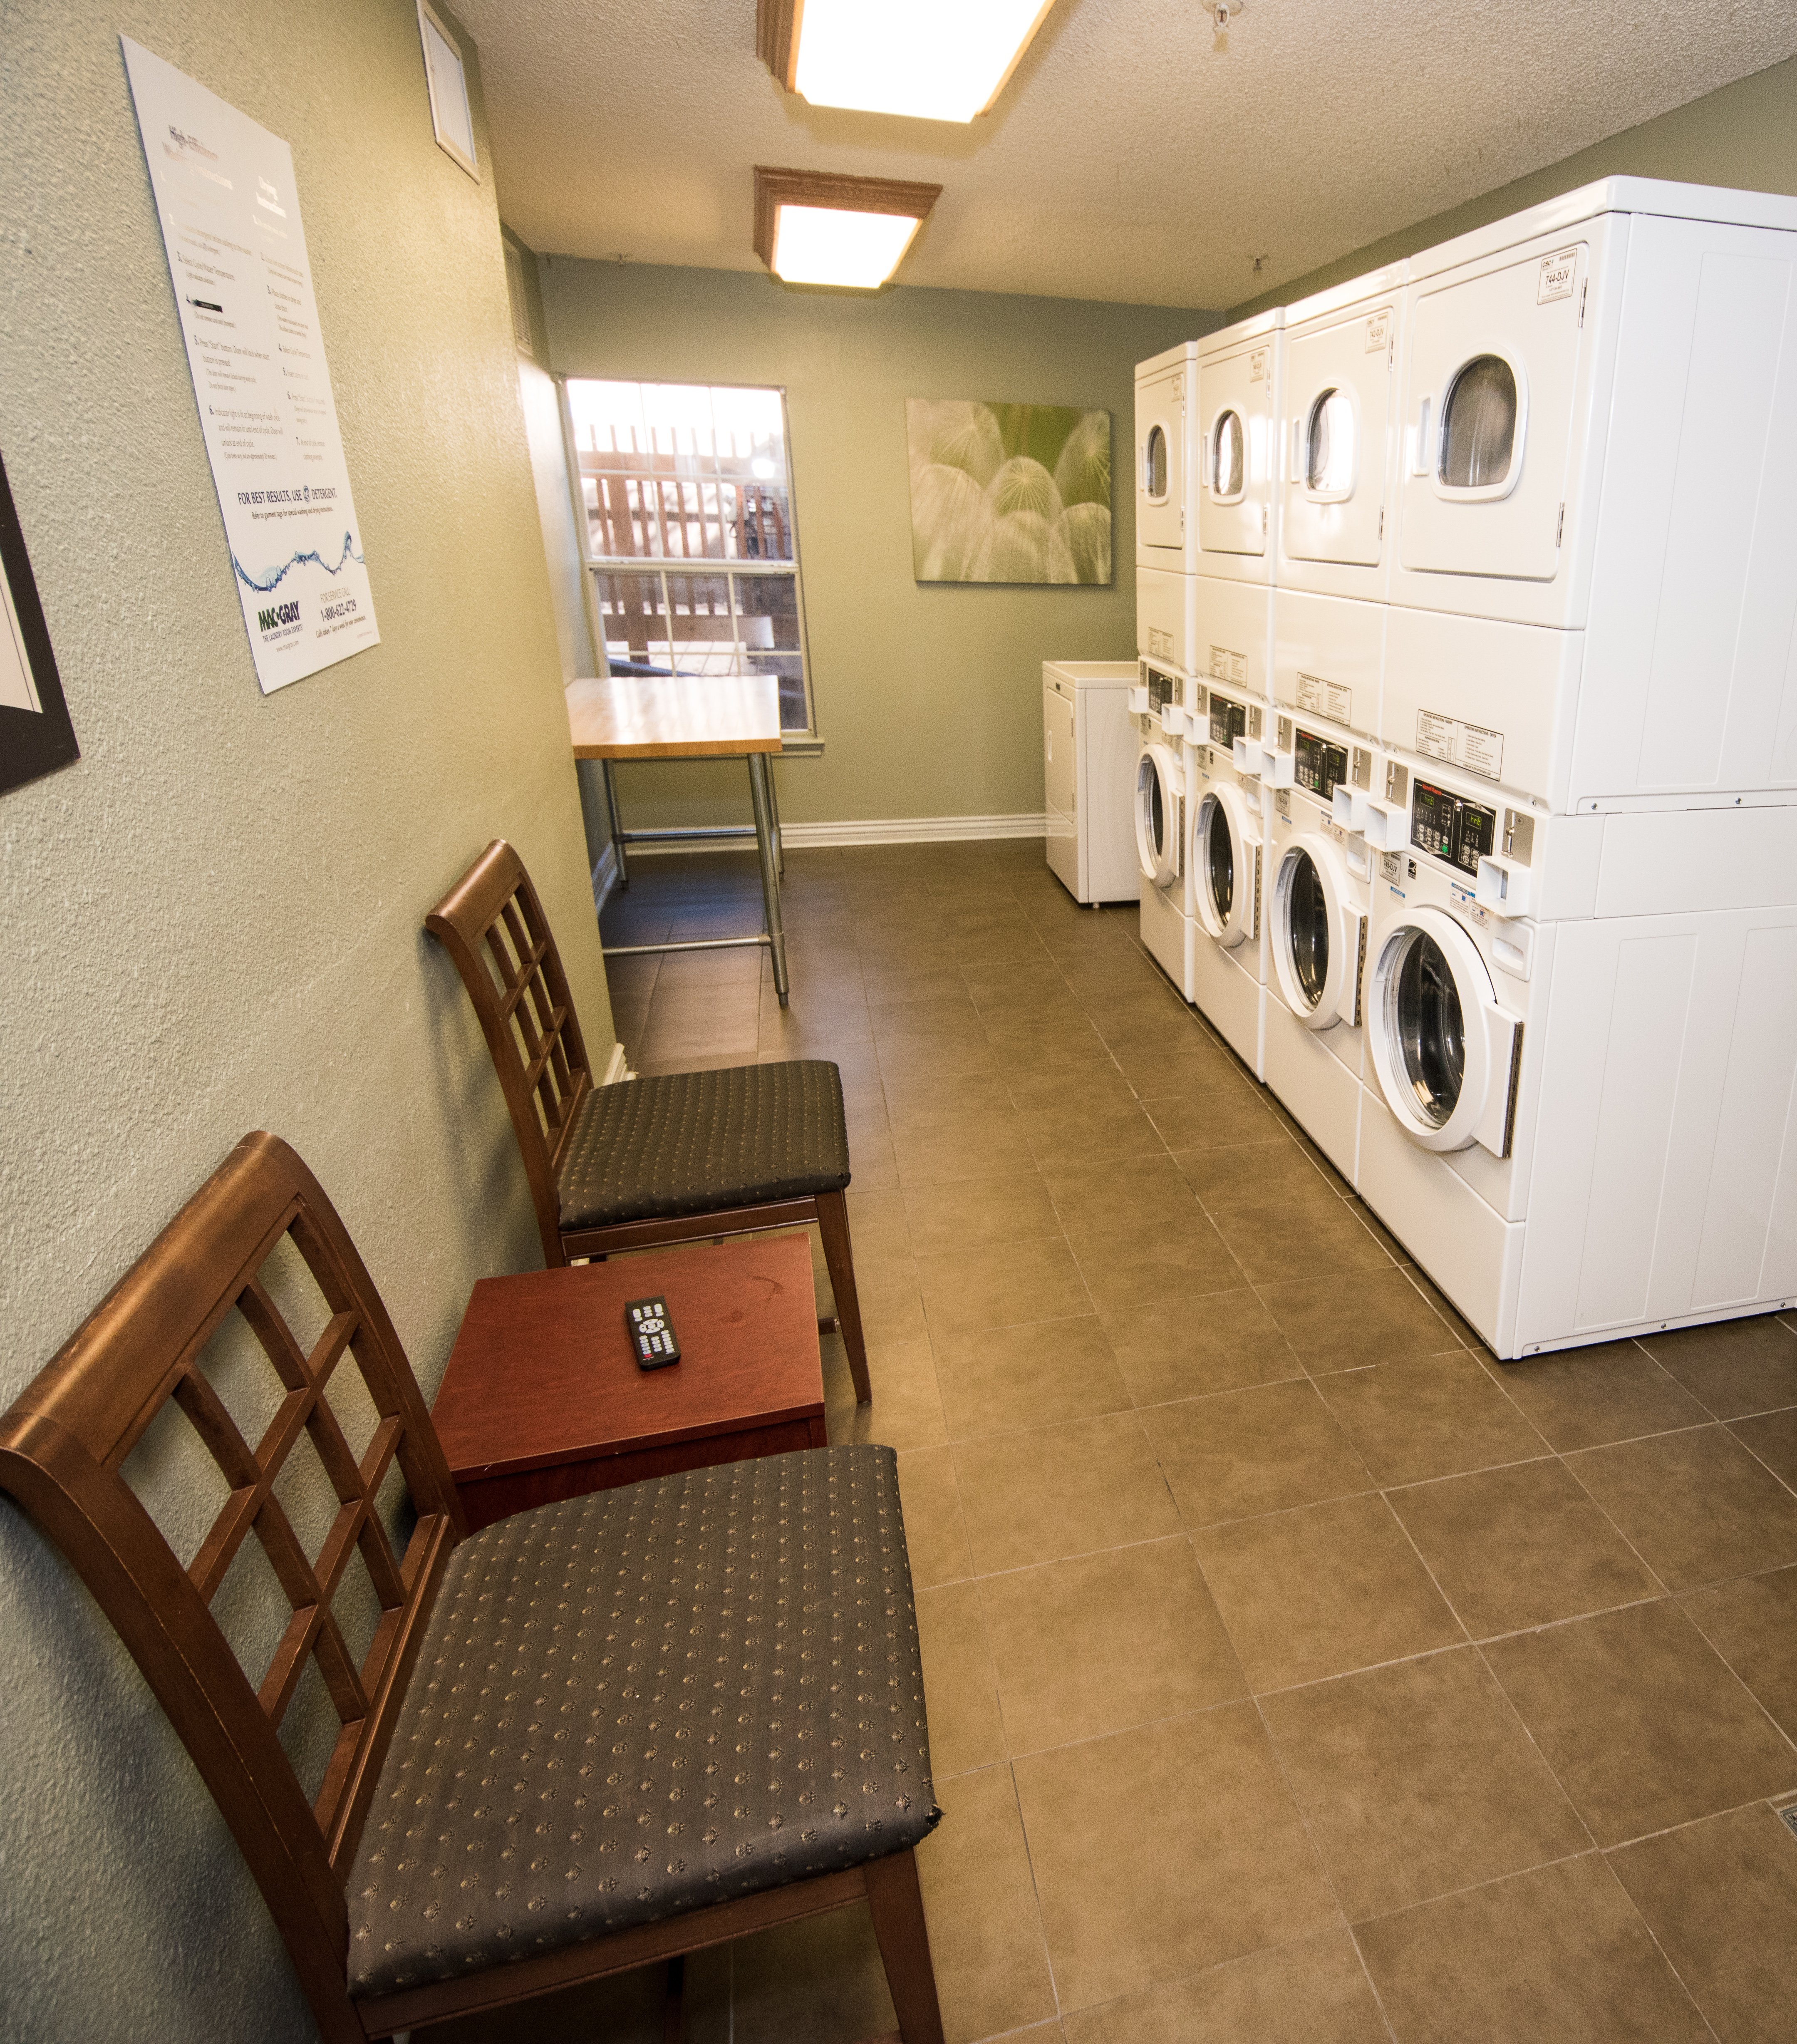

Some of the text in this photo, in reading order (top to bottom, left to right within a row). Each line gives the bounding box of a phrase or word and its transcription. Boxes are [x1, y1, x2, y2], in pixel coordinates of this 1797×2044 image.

[176, 251, 183, 263] 3.
[1546, 269, 1569, 285] 744-DJV
[266, 285, 272, 295] 3.
[193, 335, 199, 345] 5.
[278, 343, 283, 352] 4.
[282, 367, 287, 376] 5.
[287, 391, 291, 399] 6.
[208, 404, 214, 415] 6.
[229, 409, 237, 420] light
[247, 412, 263, 422] beginning
[262, 412, 266, 420] of
[258, 425, 263, 434] of
[262, 426, 270, 434] cycle.
[270, 426, 278, 434] Door
[221, 438, 232, 447] unlock
[242, 438, 246, 447] of
[246, 439, 254, 449] cycle.
[295, 436, 300, 445] 7.
[237, 488, 338, 505] FOR BEST RESULTS, USE DETERGENT.
[251, 511, 260, 519] Refer
[264, 512, 276, 521] garment
[288, 508, 297, 518] special
[297, 507, 308, 516] washing
[312, 506, 321, 515] drying
[320, 593, 329, 603] FOR
[328, 589, 342, 601] SERVICE
[320, 599, 357, 622] 1-800-622-4729
[354, 615, 366, 624] convenience.
[269, 631, 282, 641] LAUNDRY
[283, 628, 291, 636] ROOM
[291, 624, 303, 634] EXPERTS
[276, 640, 299, 652] www.macgray.com
[1383, 860, 1398, 873] 745-DJV
